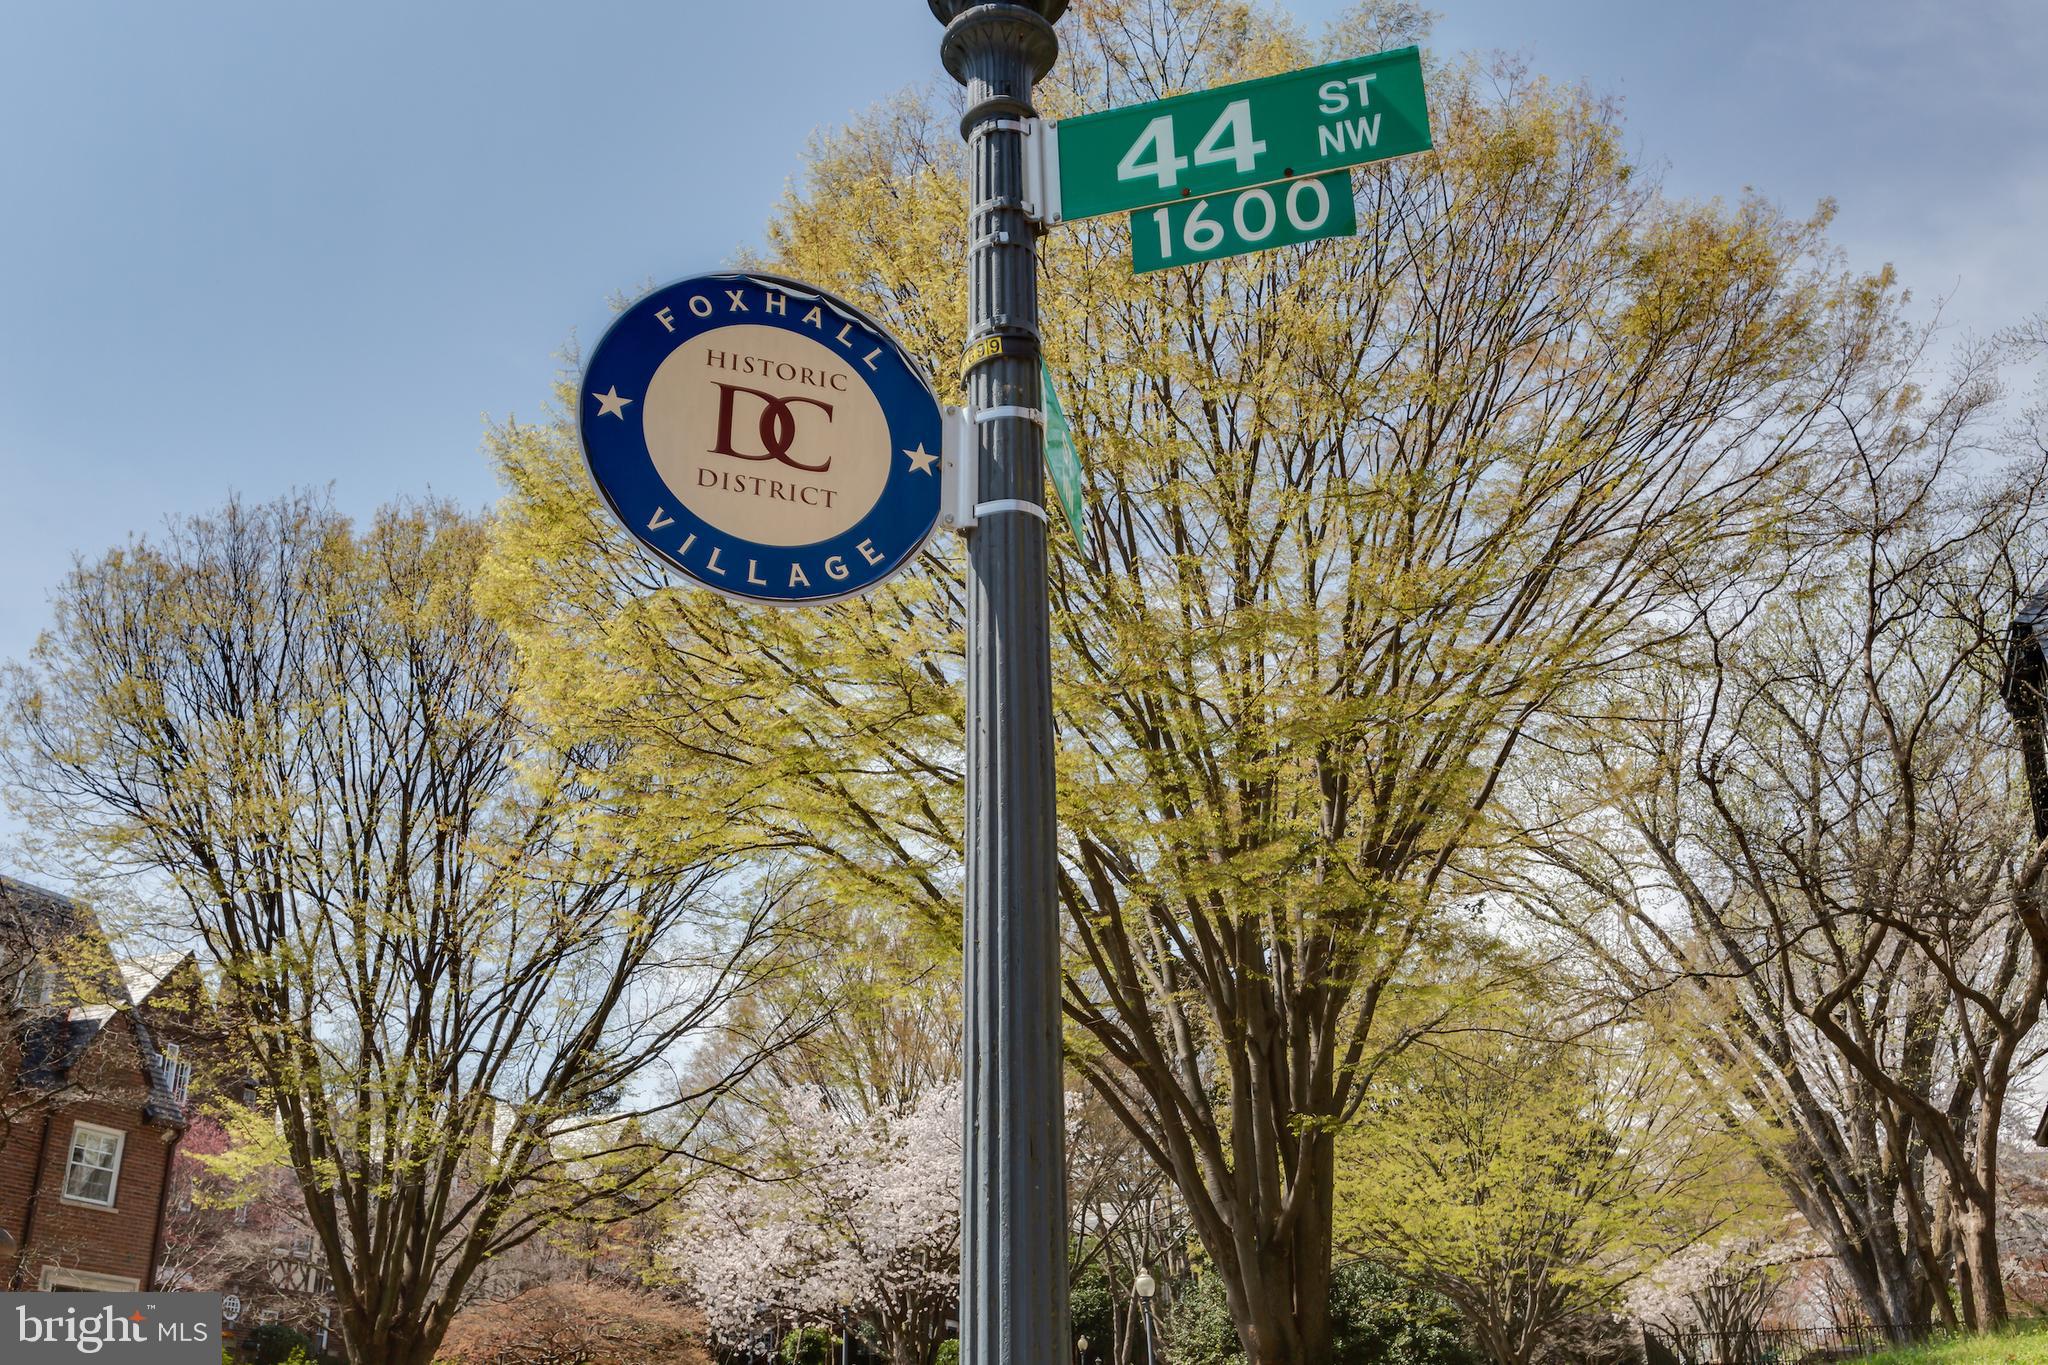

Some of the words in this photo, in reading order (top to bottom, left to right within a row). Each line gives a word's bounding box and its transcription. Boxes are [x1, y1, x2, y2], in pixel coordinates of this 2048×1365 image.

[1318, 73, 1377, 114] ST
[1116, 99, 1267, 188] 44
[1318, 113, 1381, 156] NW
[1153, 179, 1330, 258] 1600
[655, 289, 883, 371] FOXHALL
[706, 349, 848, 392] HISTORIC
[706, 381, 834, 473] DC
[697, 467, 838, 508] DISTRICT
[646, 506, 885, 587] VILLAGE
